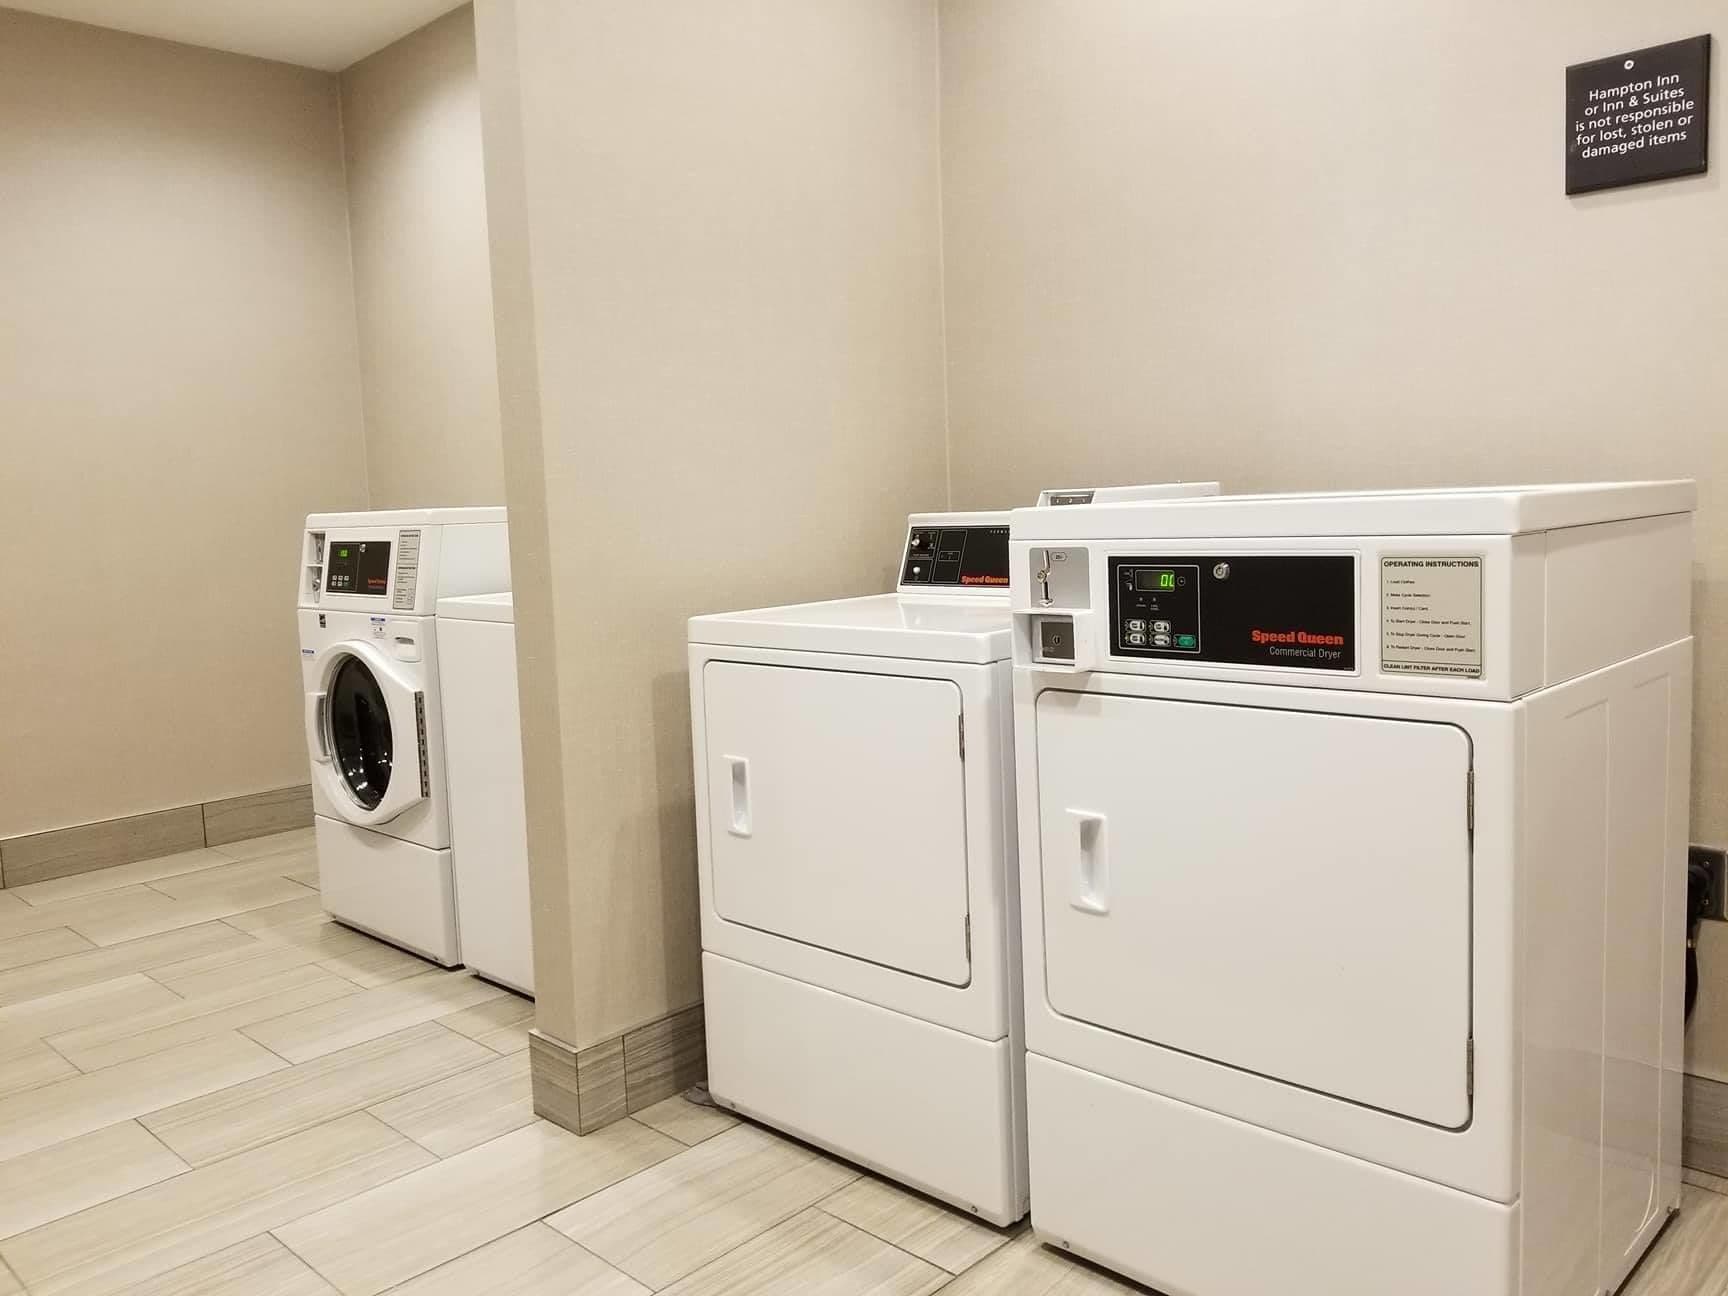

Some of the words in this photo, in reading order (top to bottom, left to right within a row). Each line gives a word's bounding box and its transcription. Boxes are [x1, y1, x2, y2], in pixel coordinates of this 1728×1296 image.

[1590, 80, 1652, 101] Hampton
[1657, 74, 1679, 86] Inn
[1585, 106, 1599, 116] or
[1603, 99, 1624, 112] Inn
[1629, 96, 1639, 107] &
[1643, 87, 1685, 104] Suites
[1576, 121, 1584, 132] is
[1589, 116, 1611, 128] not
[1616, 99, 1694, 125] responsible
[1576, 134, 1596, 145] for
[1600, 128, 1627, 141] lost,
[1631, 120, 1673, 135] stolen
[1678, 114, 1694, 124] or
[1582, 137, 1645, 158] damaged
[1649, 130, 1687, 146] items
[962, 576, 984, 584] Speed
[985, 576, 1009, 584] Queen
[1252, 630, 1295, 643] Speed
[1297, 632, 1344, 645] Queen
[1270, 646, 1316, 657] Commercial
[1319, 649, 1341, 660] Dryer
